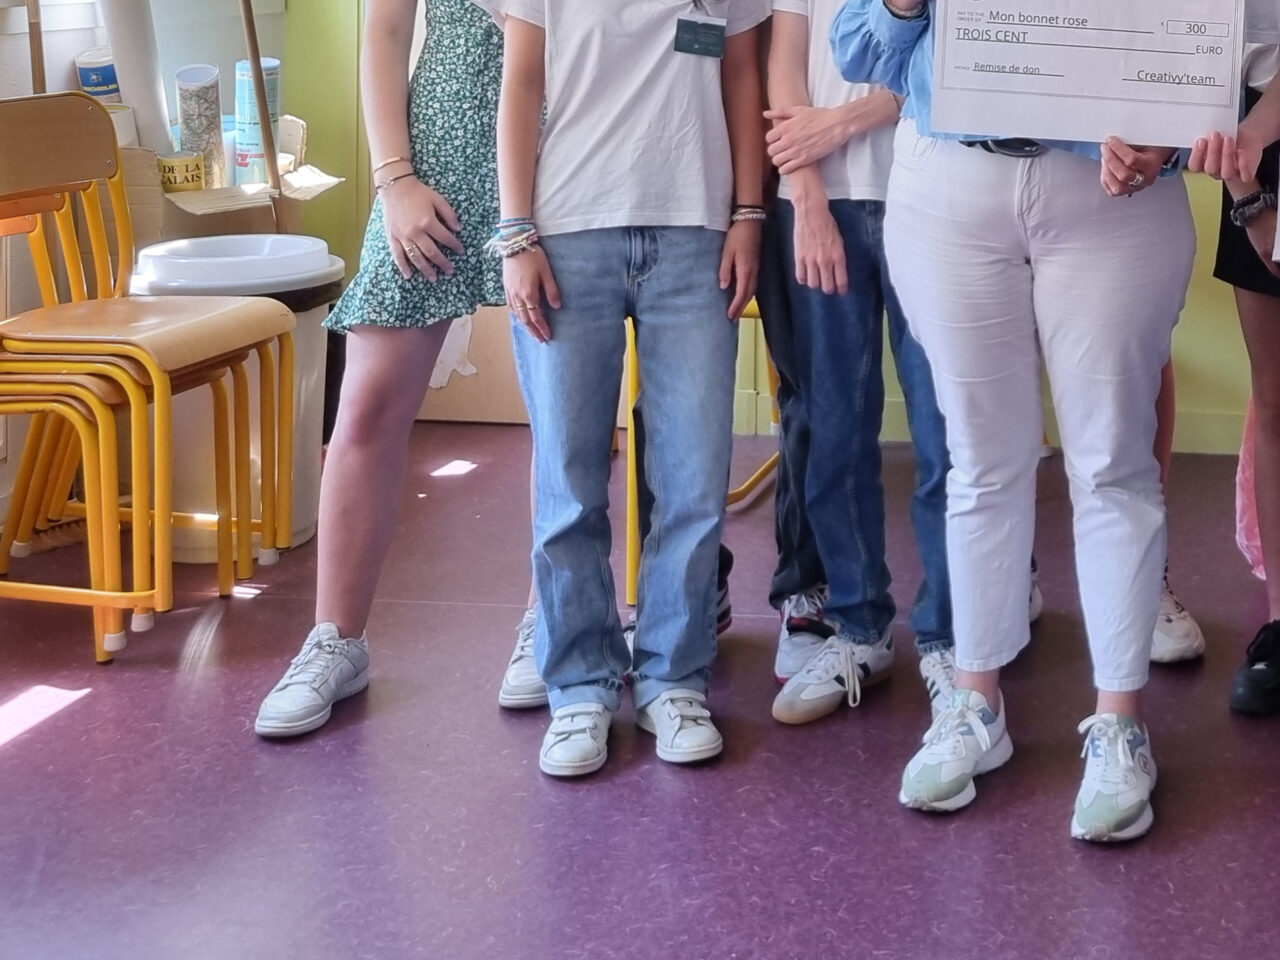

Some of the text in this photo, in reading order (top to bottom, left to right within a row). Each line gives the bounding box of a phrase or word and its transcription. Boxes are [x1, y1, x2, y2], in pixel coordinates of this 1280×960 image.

[989, 10, 1088, 27] Mon bonnet rose
[956, 27, 1029, 43] TROIS CENT
[1185, 23, 1207, 35] 300
[1195, 45, 1223, 56] EURO
[974, 61, 1041, 75] Remise de don
[1136, 69, 1216, 86] Creativy'team
[162, 163, 201, 175] DE LA
